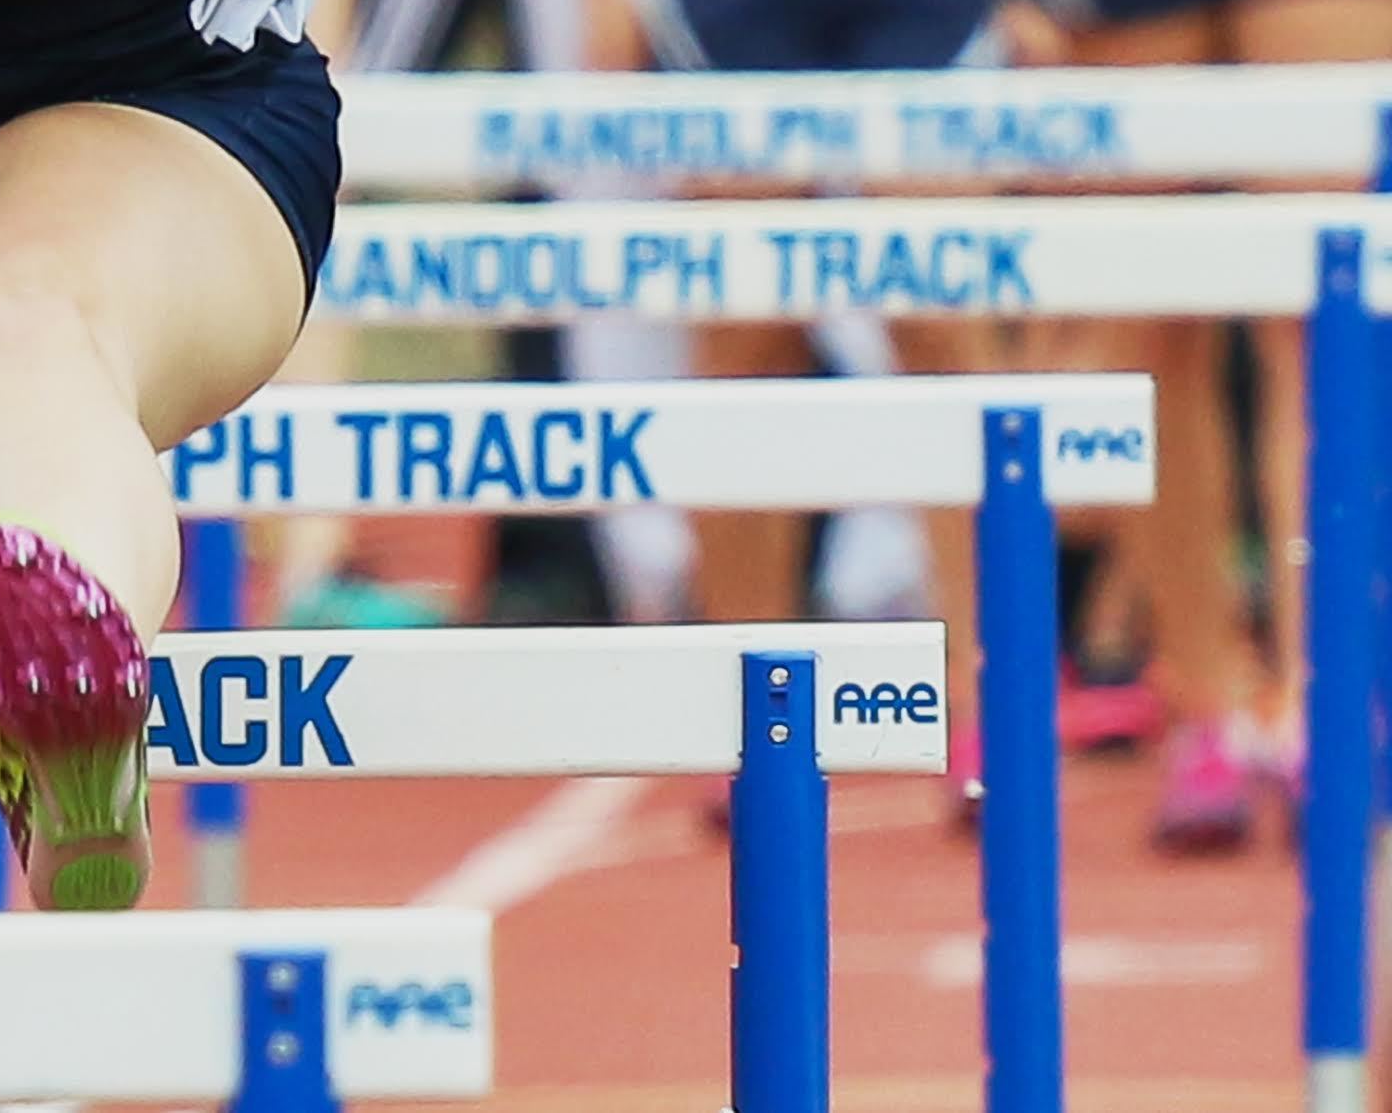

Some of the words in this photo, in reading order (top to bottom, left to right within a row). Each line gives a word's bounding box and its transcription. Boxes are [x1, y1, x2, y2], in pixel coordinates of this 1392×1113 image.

[476, 108, 864, 172] RANDOLPH
[898, 102, 1130, 168] TRACK
[320, 232, 725, 310] ANDOLPH
[766, 228, 1036, 307] TRACK
[338, 409, 656, 501] TRACK
[146, 654, 355, 767] ACK
